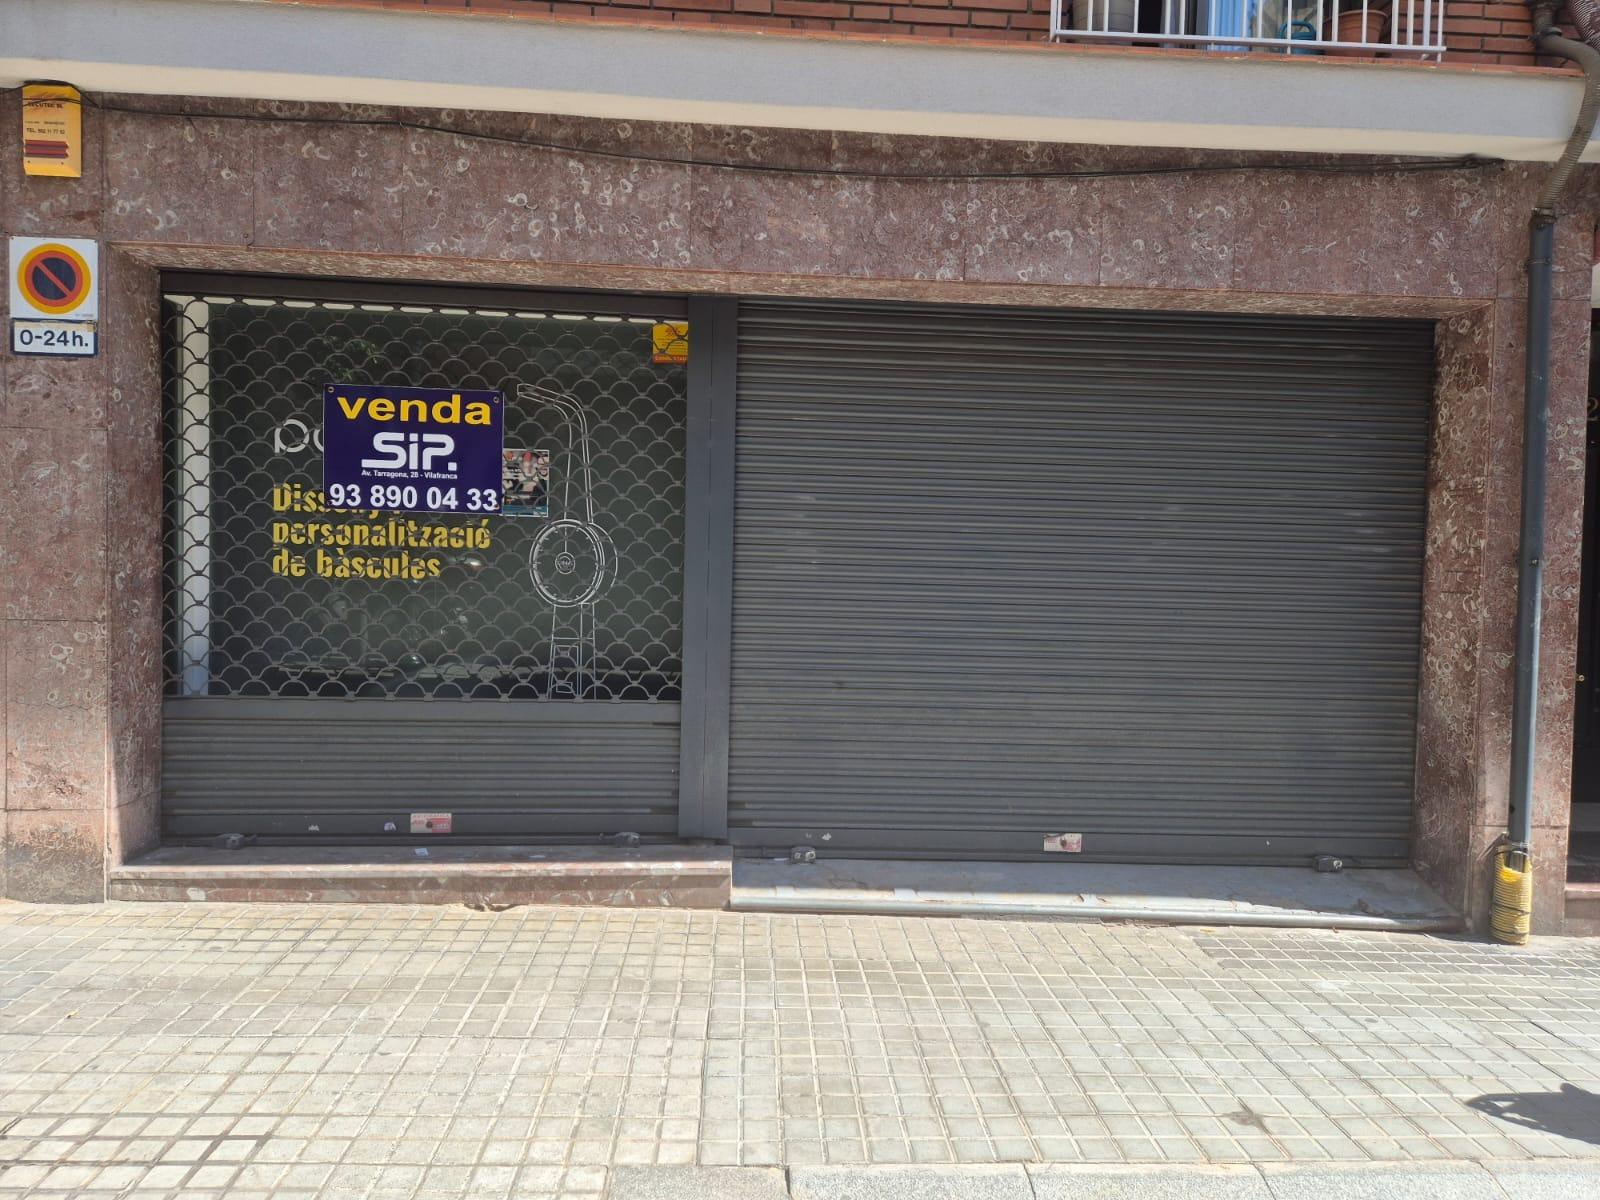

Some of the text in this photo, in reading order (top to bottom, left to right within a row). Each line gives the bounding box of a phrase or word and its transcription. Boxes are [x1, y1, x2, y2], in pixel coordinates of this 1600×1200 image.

[337, 394, 491, 425] venda
[374, 470, 409, 478] Tarragona,
[329, 484, 498, 511] 93 890 04 33
[273, 518, 491, 549] personalització
[272, 548, 441, 580] de bàscules
